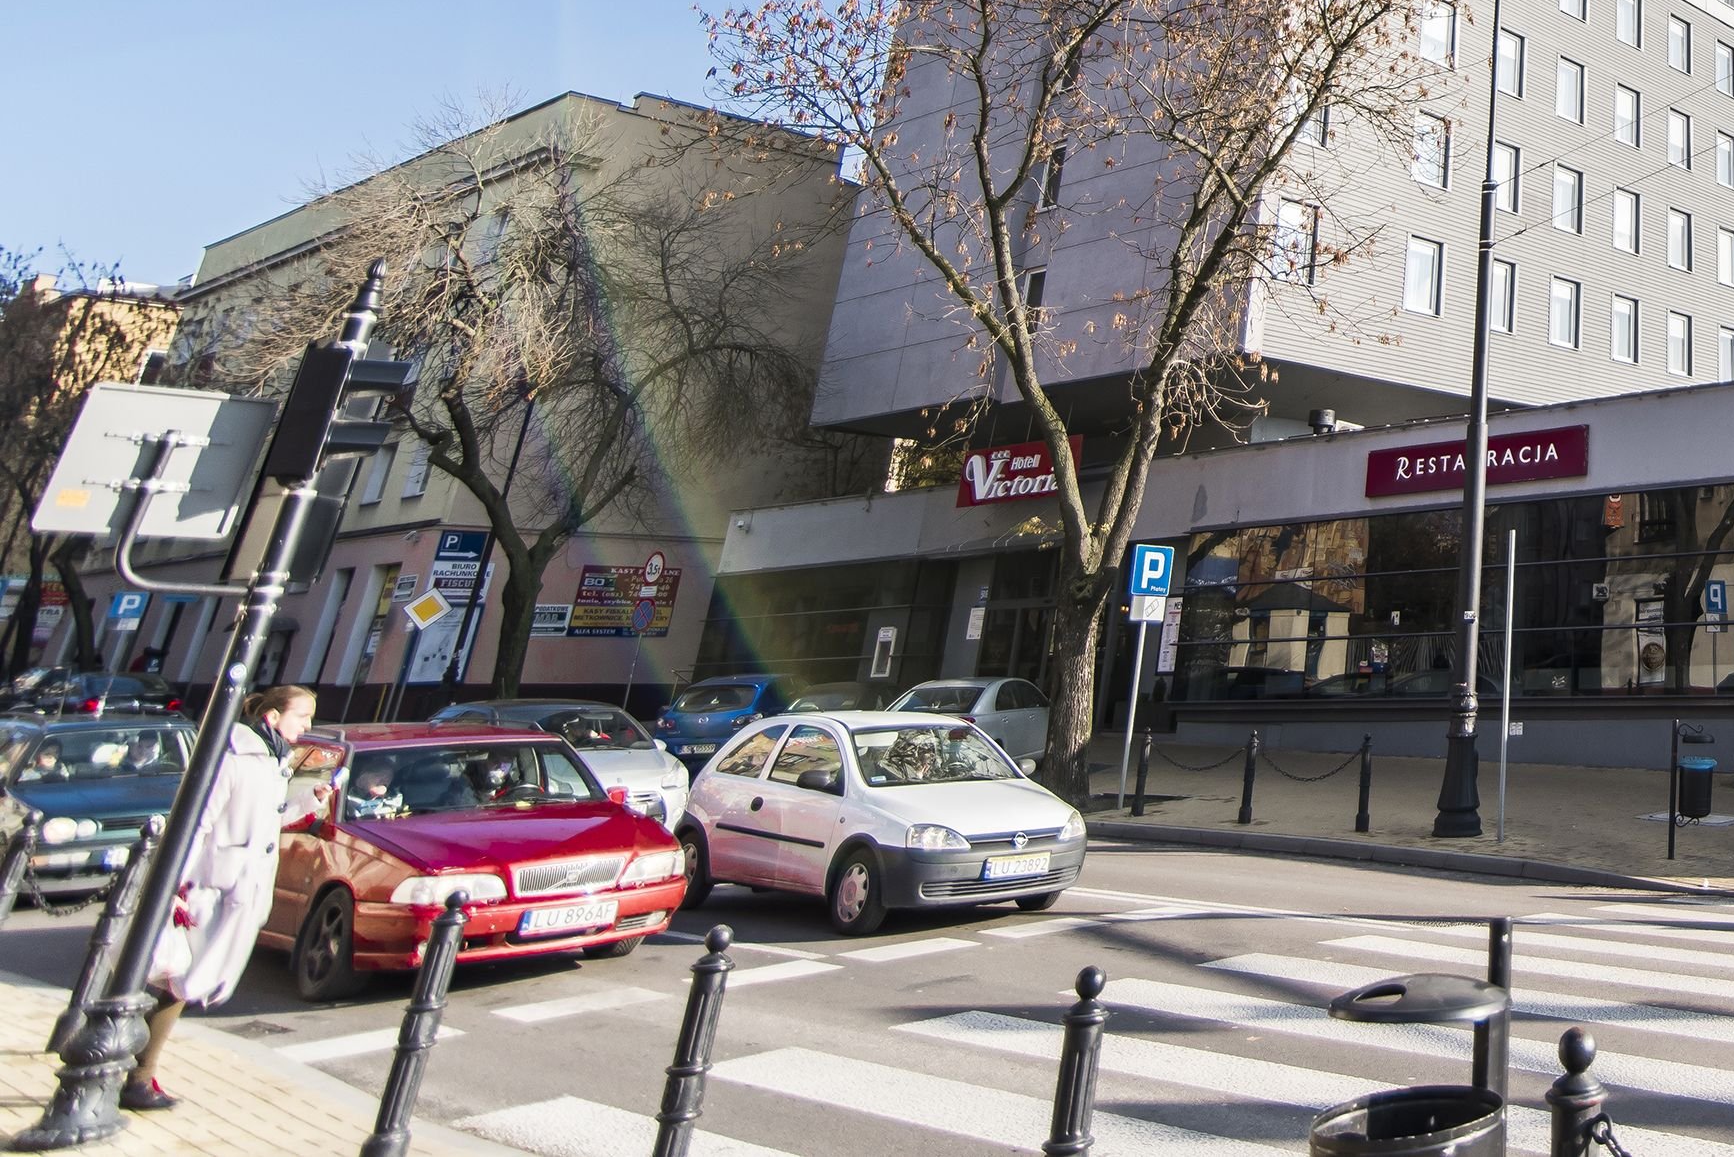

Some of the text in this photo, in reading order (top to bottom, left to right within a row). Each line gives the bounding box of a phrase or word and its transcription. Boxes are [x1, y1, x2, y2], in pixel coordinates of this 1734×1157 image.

[1395, 442, 1560, 481] RESTARACJA
[445, 535, 458, 548] P
[433, 569, 491, 578] RACHUNKOE
[1141, 550, 1166, 589] P
[118, 595, 141, 614] P
[993, 857, 1048, 875] LU 23892
[534, 903, 615, 928] LU 896AF
